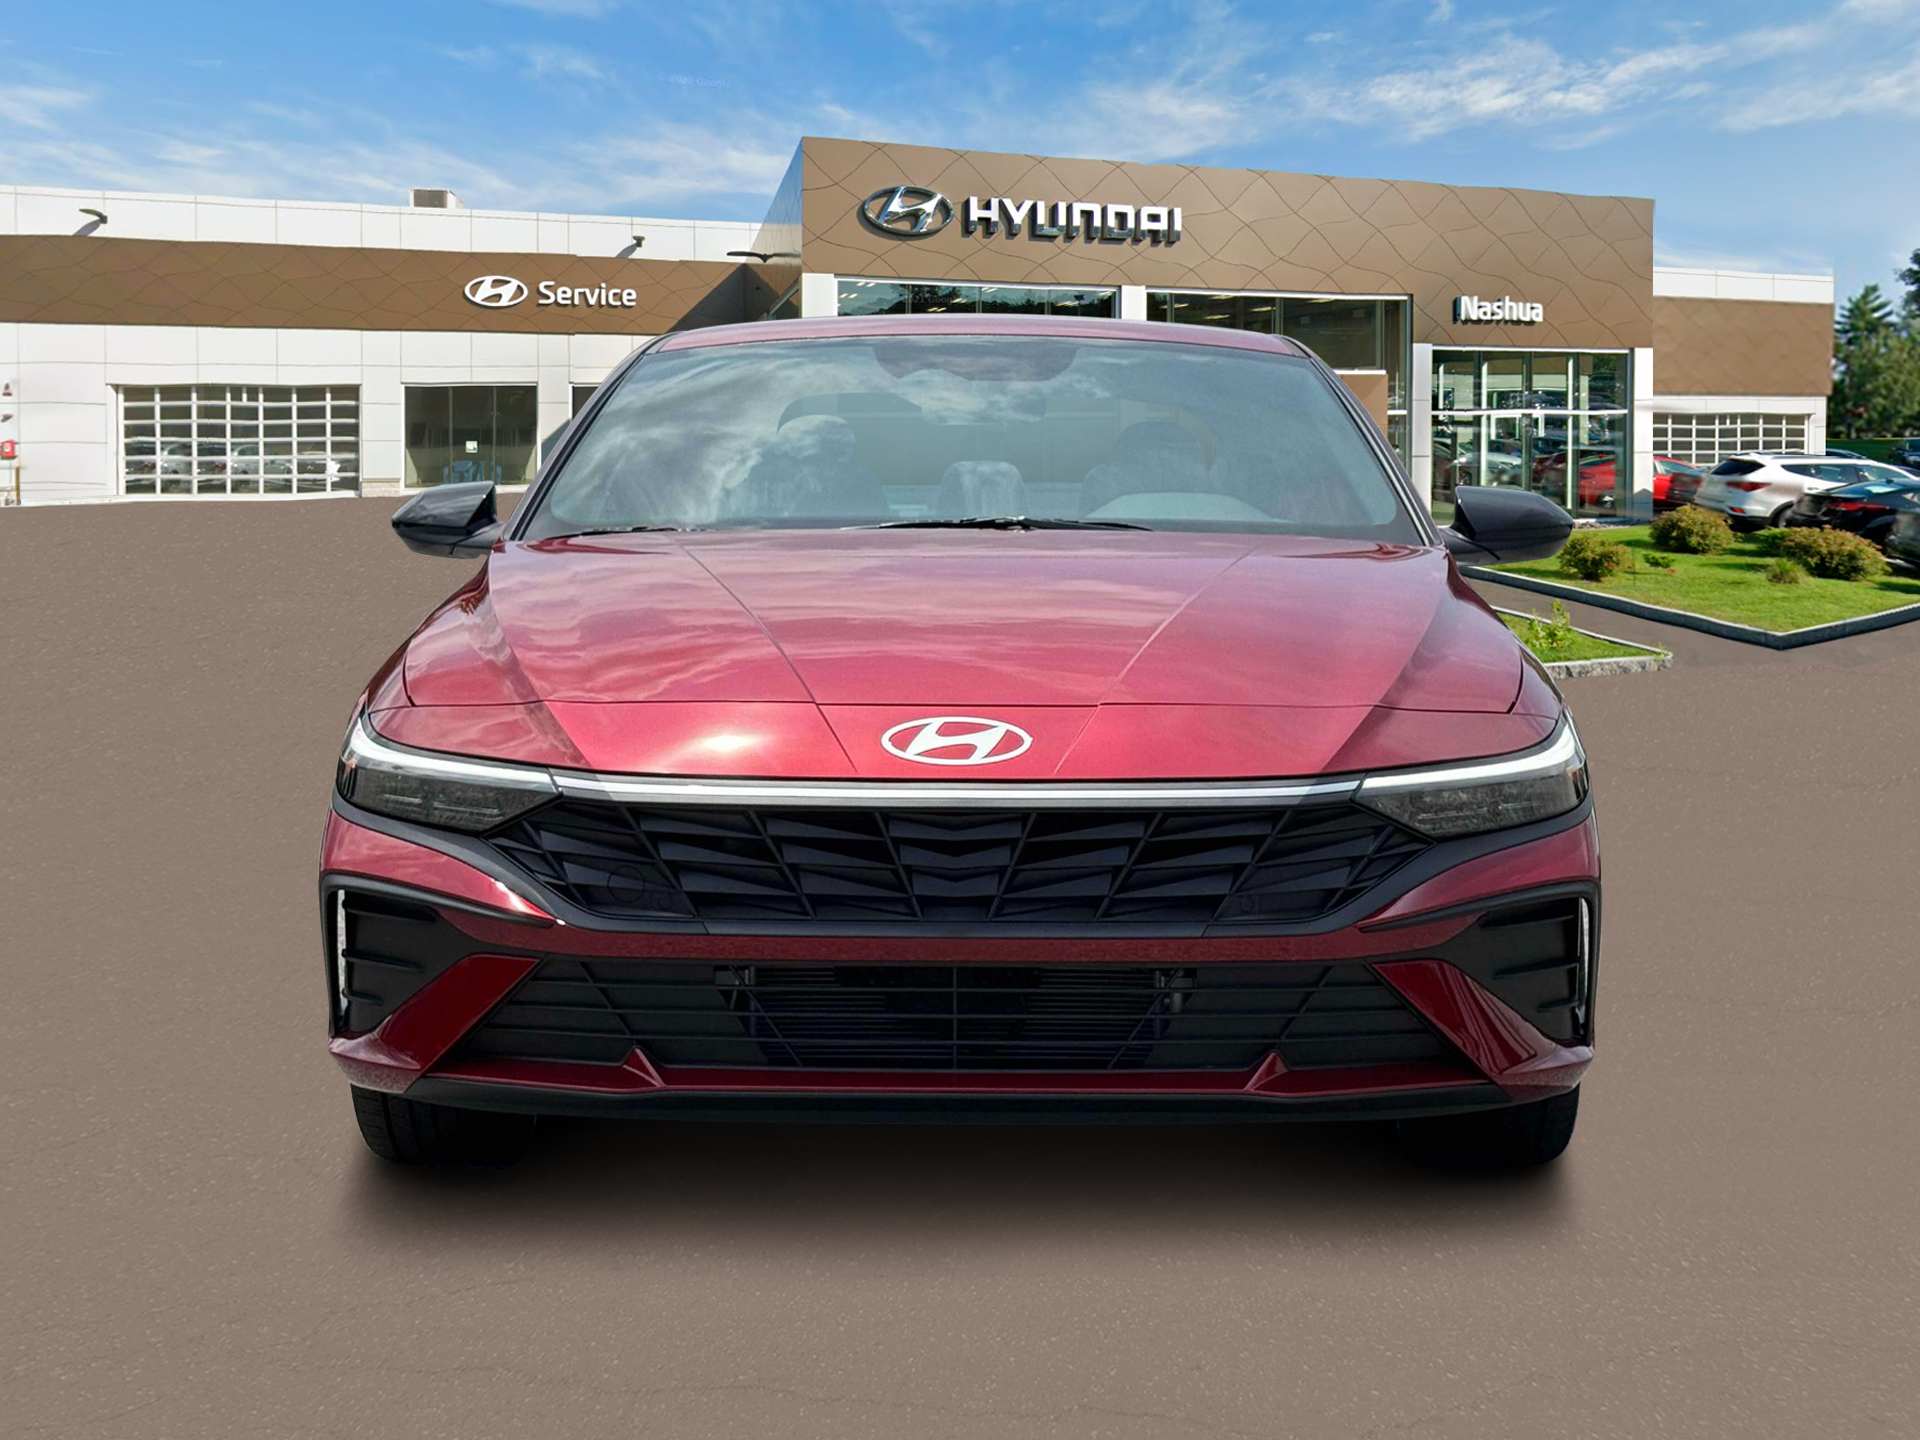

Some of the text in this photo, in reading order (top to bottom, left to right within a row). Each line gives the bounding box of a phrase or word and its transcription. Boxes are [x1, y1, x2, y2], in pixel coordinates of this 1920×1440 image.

[967, 195, 1182, 244] HYUNDAI
[538, 281, 637, 306] Service
[1459, 295, 1544, 322] Nashua
